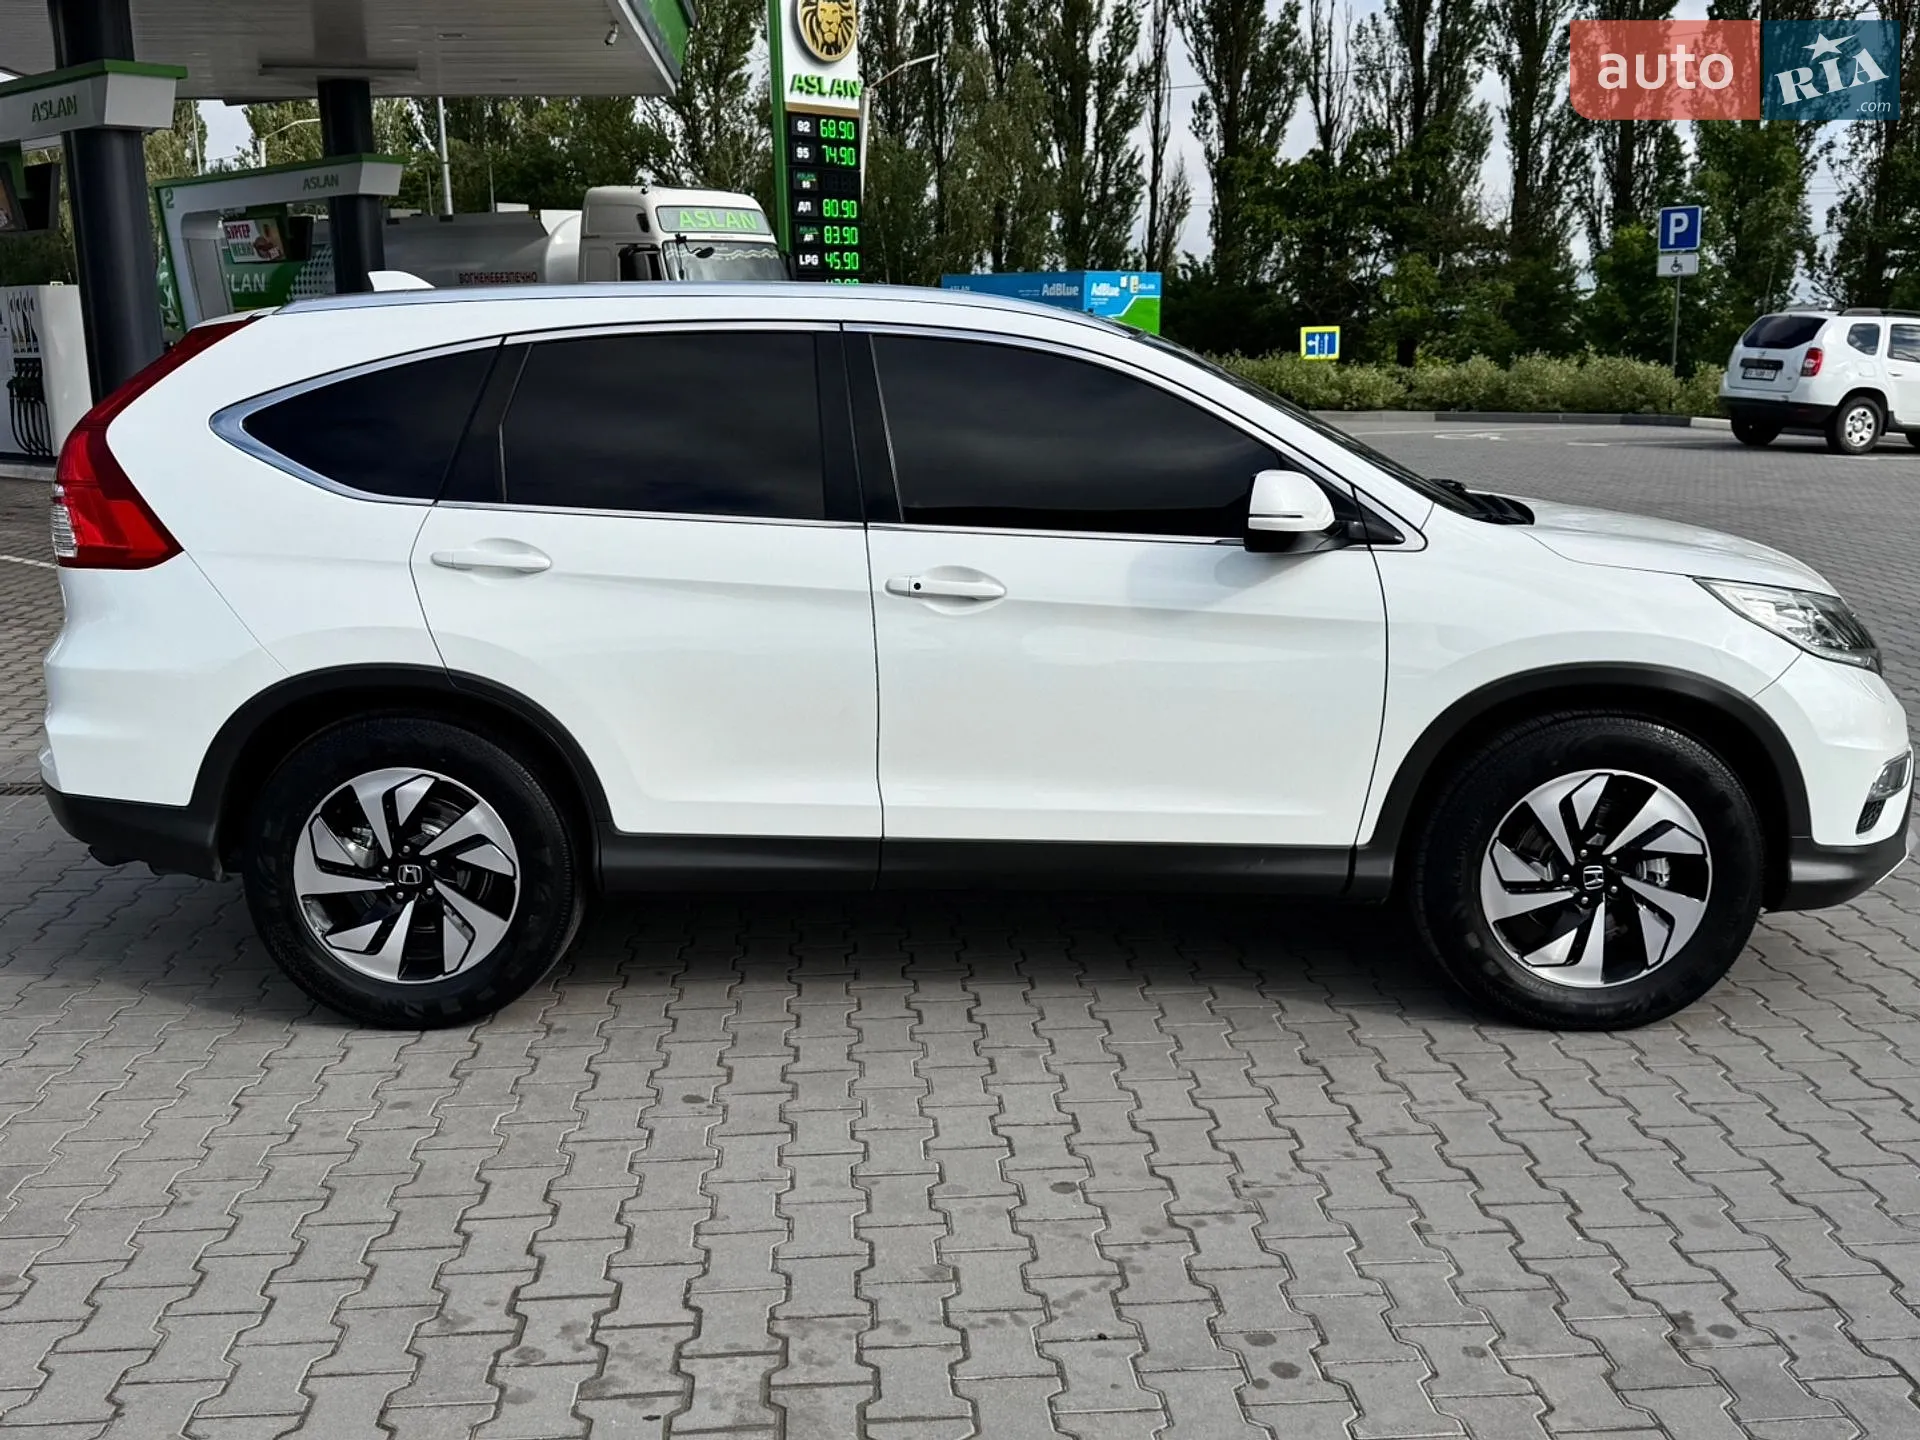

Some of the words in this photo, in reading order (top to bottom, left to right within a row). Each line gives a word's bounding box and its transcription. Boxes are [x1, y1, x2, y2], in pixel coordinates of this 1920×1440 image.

[790, 73, 861, 99] ASLAN
[31, 95, 78, 122] ASLAN
[820, 118, 855, 140] 68.90
[821, 144, 856, 166] 74.90
[302, 174, 340, 191] ASLAN
[164, 188, 174, 208] 2
[822, 198, 858, 219] 80.90
[679, 209, 758, 230] ASLAN
[1668, 212, 1689, 246] P
[823, 225, 859, 246] 83.90
[799, 254, 819, 266] LPG
[824, 251, 859, 271] 45.90
[1041, 283, 1079, 297] AdBlue
[1091, 282, 1120, 297] AdBlue
